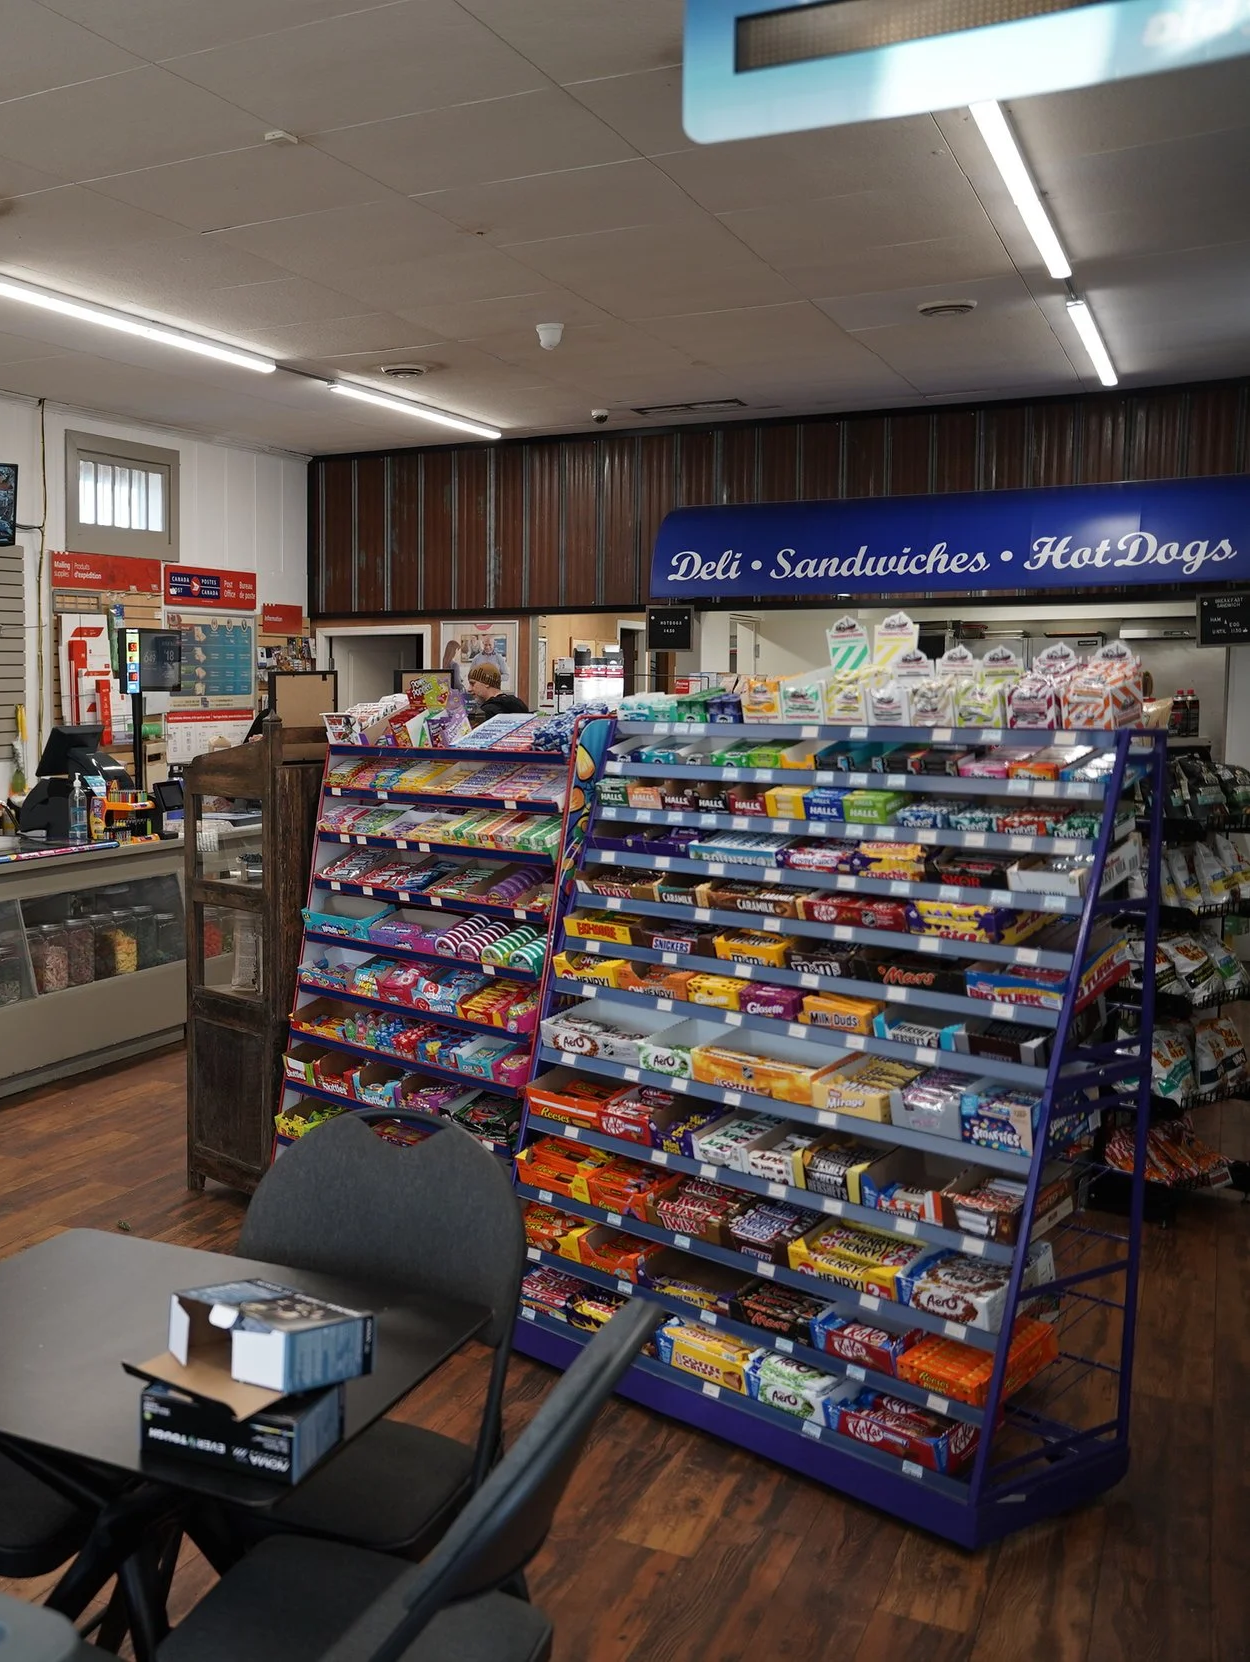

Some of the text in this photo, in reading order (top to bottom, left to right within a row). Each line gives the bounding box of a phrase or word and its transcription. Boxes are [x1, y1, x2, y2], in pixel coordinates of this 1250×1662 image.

[54, 561, 70, 570] Mailing
[667, 550, 744, 582] Deli
[769, 542, 992, 580] Sandwiches
[201, 578, 217, 586] POSTES
[224, 580, 233, 589] Post
[601, 792, 623, 801] HALLS
[632, 793, 655, 802] HALLS
[665, 795, 688, 805] HALLS
[699, 799, 724, 809] HALLS
[735, 800, 762, 811] HALLS
[809, 806, 838, 817] HALLS
[850, 807, 878, 818] HALLS
[941, 875, 981, 887] SKOR
[662, 892, 693, 905] CARAMILK
[737, 900, 775, 913] CARAMILK
[653, 938, 690, 953] SNICKERS
[883, 967, 935, 985] Mars
[998, 991, 1043, 1005] TURK
[747, 1001, 784, 1014] Glosette
[810, 1013, 858, 1027] Milk Duds
[323, 1083, 348, 1096] Skittles
[827, 1098, 864, 1108] Mirage
[658, 1212, 699, 1234] TWIX
[820, 1235, 886, 1262] OH HENRY!
[822, 1254, 868, 1278] HENRY!
[752, 1313, 791, 1331] Mars
[682, 1355, 721, 1374] COFFEE
[682, 1361, 716, 1377] CRISP
[848, 1420, 884, 1443] KitKat
